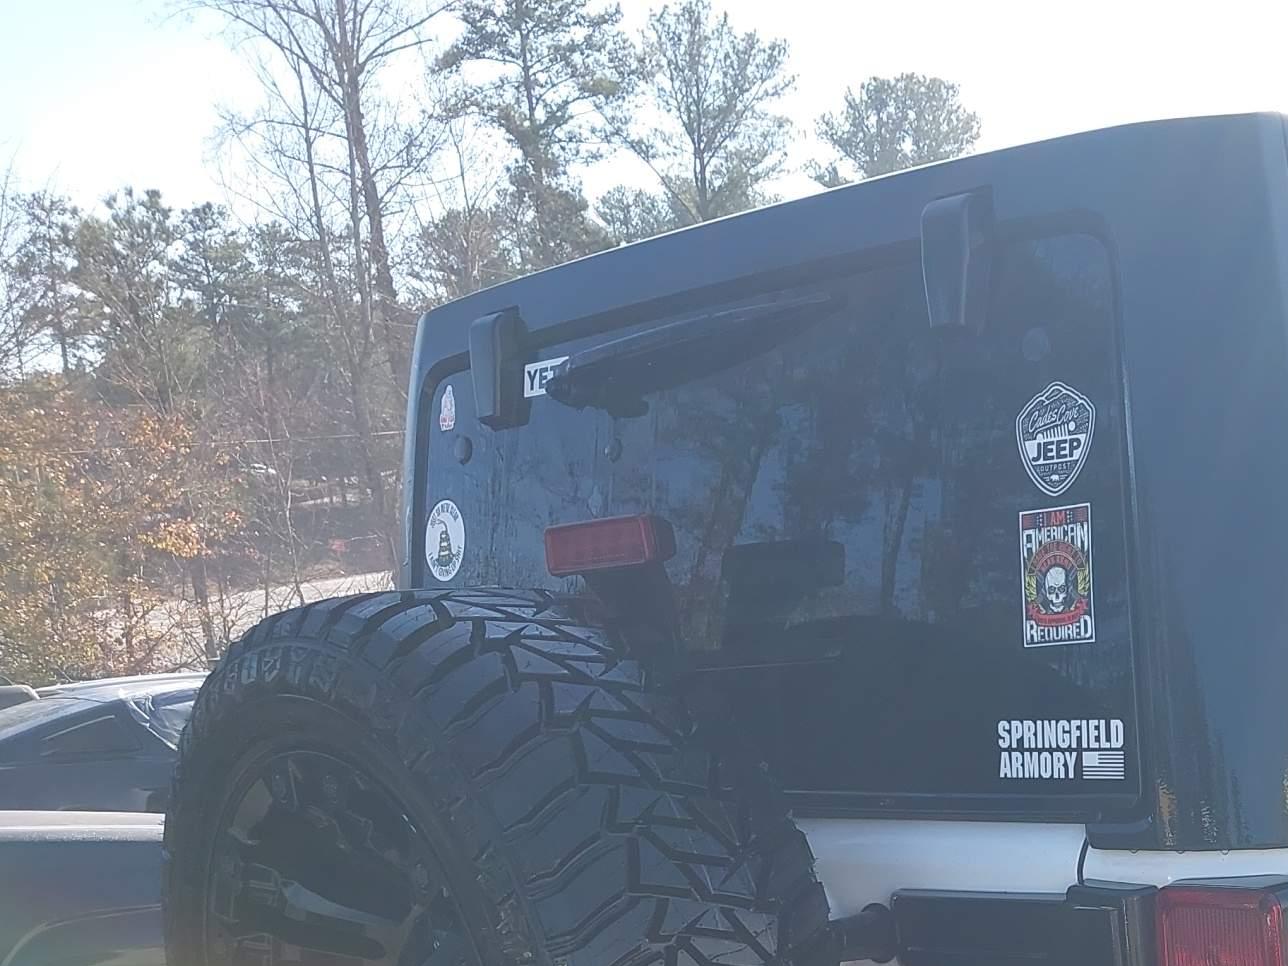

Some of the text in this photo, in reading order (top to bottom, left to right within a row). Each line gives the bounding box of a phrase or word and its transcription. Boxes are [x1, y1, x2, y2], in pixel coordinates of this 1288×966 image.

[526, 365, 561, 392] YE
[1028, 404, 1079, 433] Cades Cove
[1031, 437, 1082, 463] JEEP
[1040, 462, 1071, 472] OUTPOST
[1050, 511, 1065, 526] AM
[1023, 521, 1089, 559] AMERICAN
[1026, 615, 1092, 644] REQUIRED
[998, 719, 1124, 749] SPRINGFIELD
[1000, 751, 1078, 779] ARMORY
